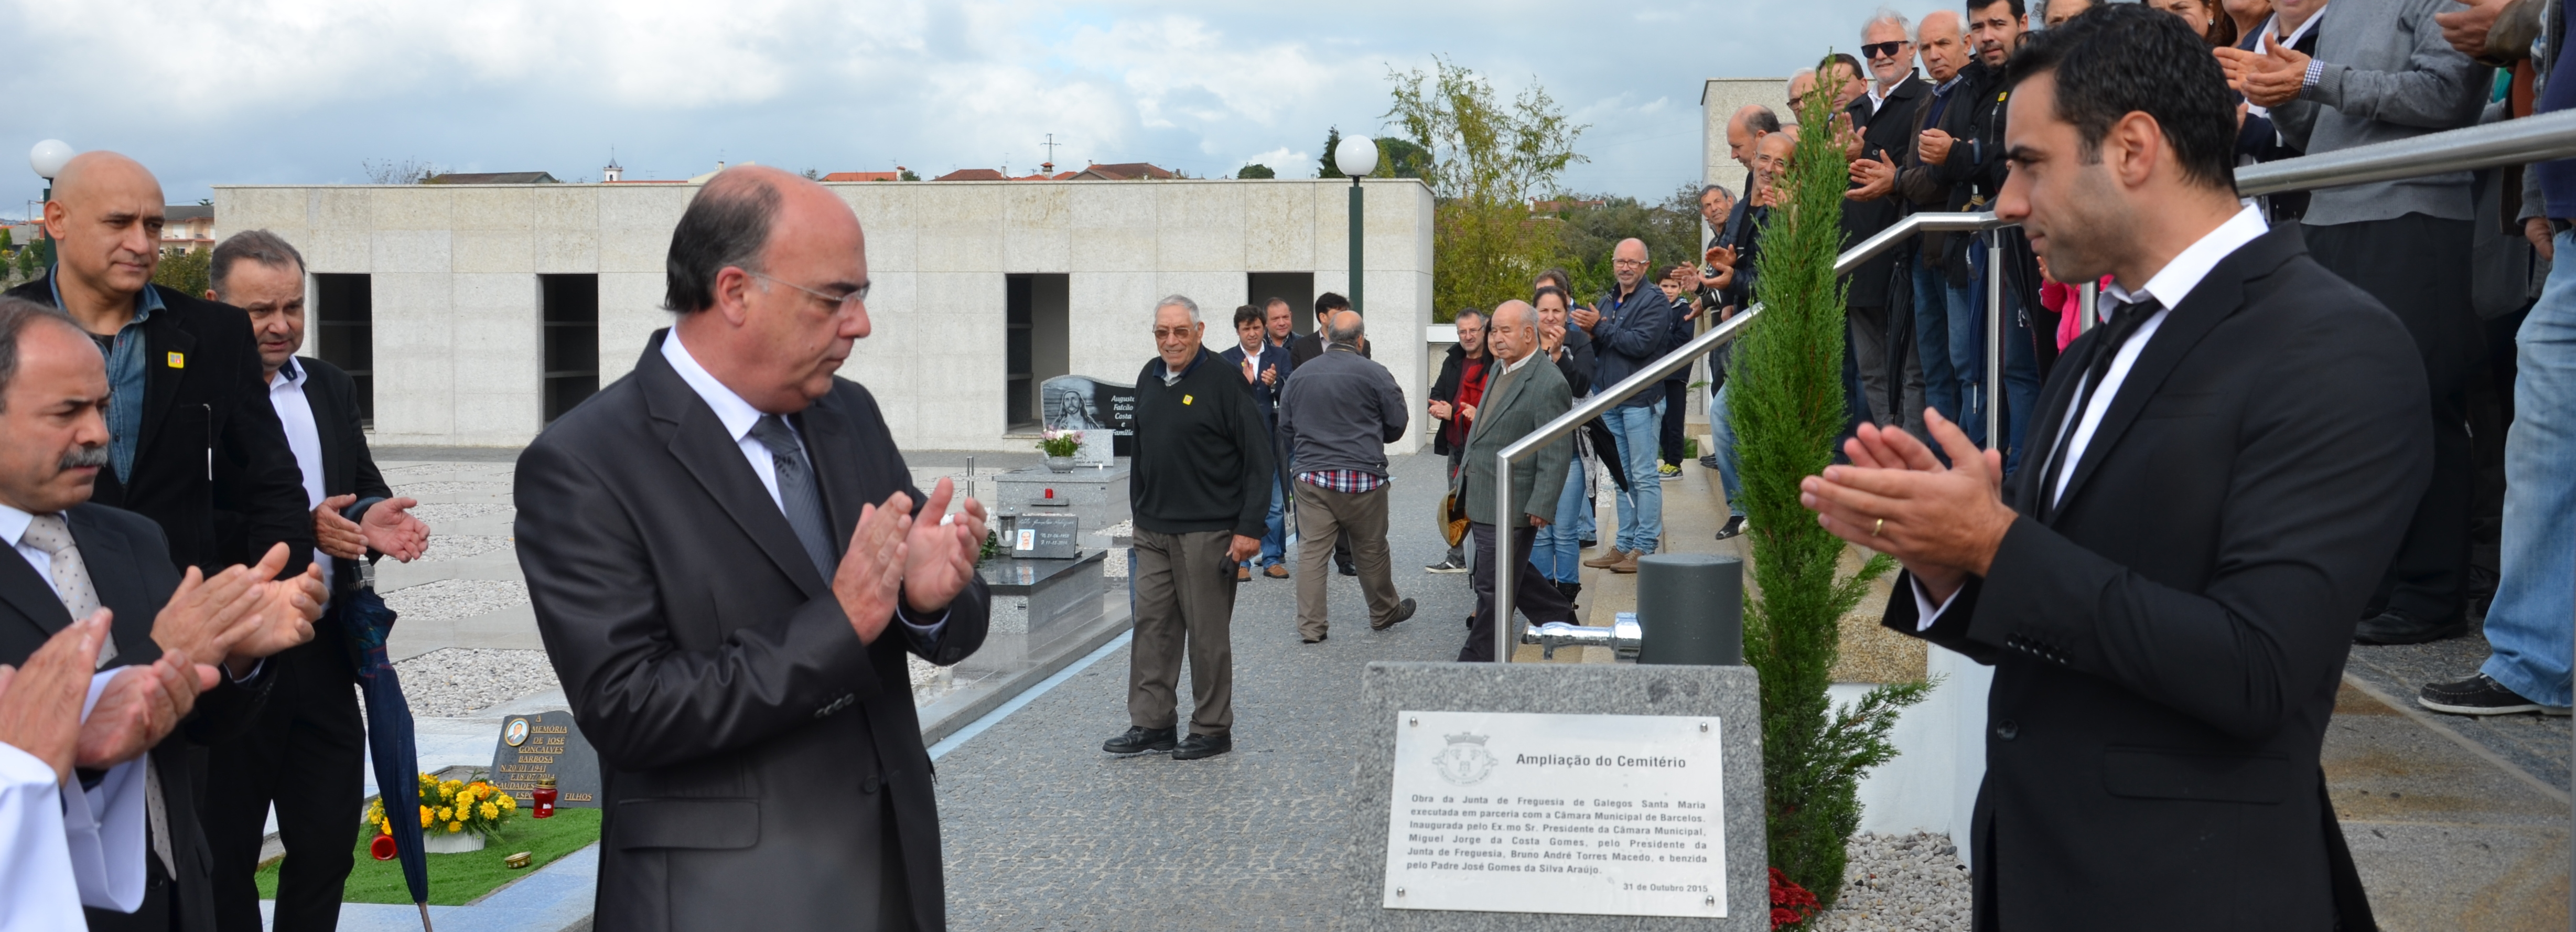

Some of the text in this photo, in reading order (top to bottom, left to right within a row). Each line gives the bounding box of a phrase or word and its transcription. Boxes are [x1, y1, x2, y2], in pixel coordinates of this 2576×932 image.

[518, 755, 554, 764] BARBOSA
[1515, 753, 1686, 768] Ampliação do Cemitério
[500, 764, 546, 773] N.20/01/1941
[495, 781, 535, 790] SAUDADES
[564, 793, 592, 801] FILHOS
[1411, 795, 1433, 803] Obra
[1517, 797, 1564, 807] Freguesia
[1593, 799, 1632, 809] Galegos
[1641, 800, 1668, 809] Santa
[1677, 801, 1706, 809] Maria
[1554, 811, 1591, 820] Câmara
[1594, 812, 1642, 822] Municipal
[1660, 813, 1706, 823] Barcelos.
[1409, 821, 1463, 831] Inaugurada
[1467, 822, 1488, 831] pelo
[1491, 823, 1521, 832] Ex.mo
[1525, 823, 1538, 832] Sr.
[1542, 824, 1594, 833] Presidente
[1613, 826, 1651, 835] Câmara
[1654, 827, 1706, 838] Municipal,
[1408, 834, 1443, 844] Miguel
[1452, 835, 1481, 845] Jorge
[1511, 837, 1539, 845] Costa
[1549, 837, 1588, 848] Gomes,
[1598, 839, 1620, 849] pelo
[1629, 839, 1685, 849] Presidente
[1694, 841, 1707, 850] da
[1407, 848, 1433, 856] Junta
[1438, 848, 1450, 856] de
[1454, 848, 1505, 859] Freguesia,
[1511, 850, 1539, 859] Bruno
[1543, 851, 1571, 860] André
[1576, 852, 1607, 861] Torres
[1612, 852, 1654, 863] Macedo,
[1669, 854, 1707, 863] benzida
[1406, 861, 1428, 870] pelo
[1430, 861, 1459, 871] Padre
[1461, 863, 1484, 871] José
[1487, 863, 1521, 872] Gomes
[1539, 864, 1563, 873] Silva
[1566, 865, 1602, 876] Araújo.
[1650, 884, 1684, 892] Outubro
